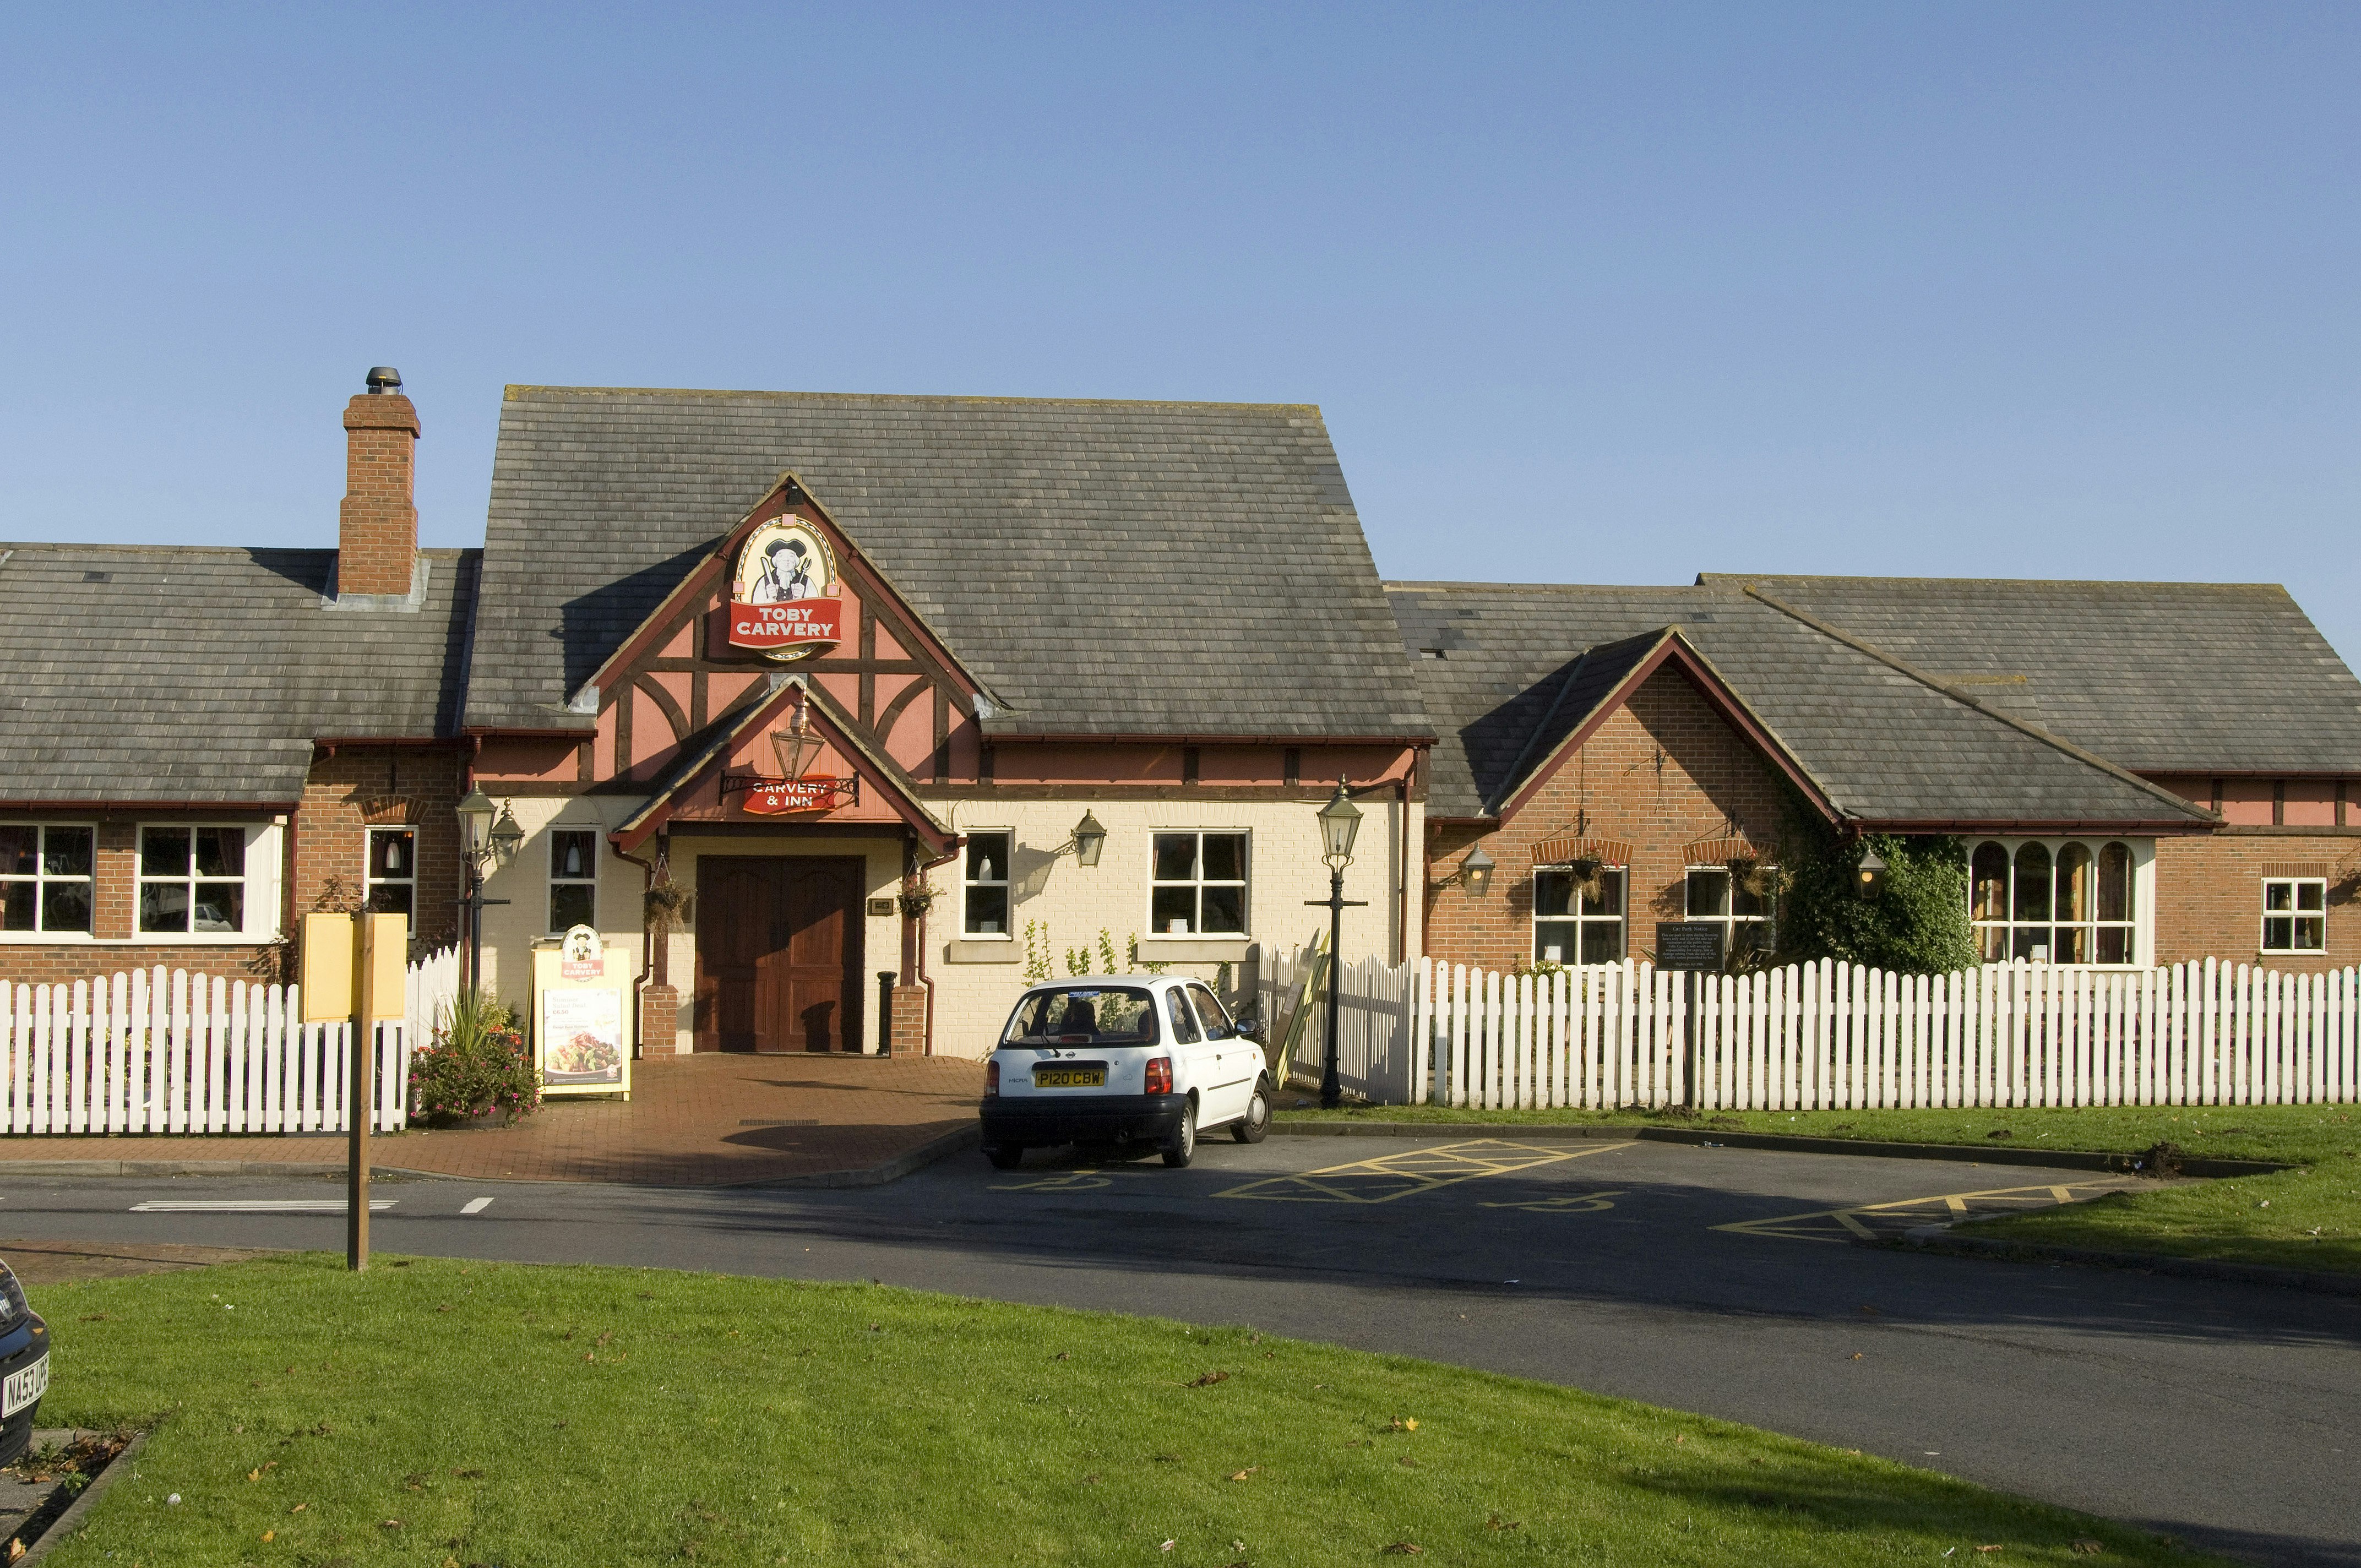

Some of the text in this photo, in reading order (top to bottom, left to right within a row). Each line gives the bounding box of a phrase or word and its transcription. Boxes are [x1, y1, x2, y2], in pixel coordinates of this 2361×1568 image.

[759, 607, 813, 622] TOBY
[736, 622, 834, 636] CARVERY
[753, 782, 827, 794] CARVERY
[766, 795, 813, 807] & INN
[1040, 1072, 1101, 1085] P120 CBW
[8, 1357, 48, 1409] NA53 UPE
